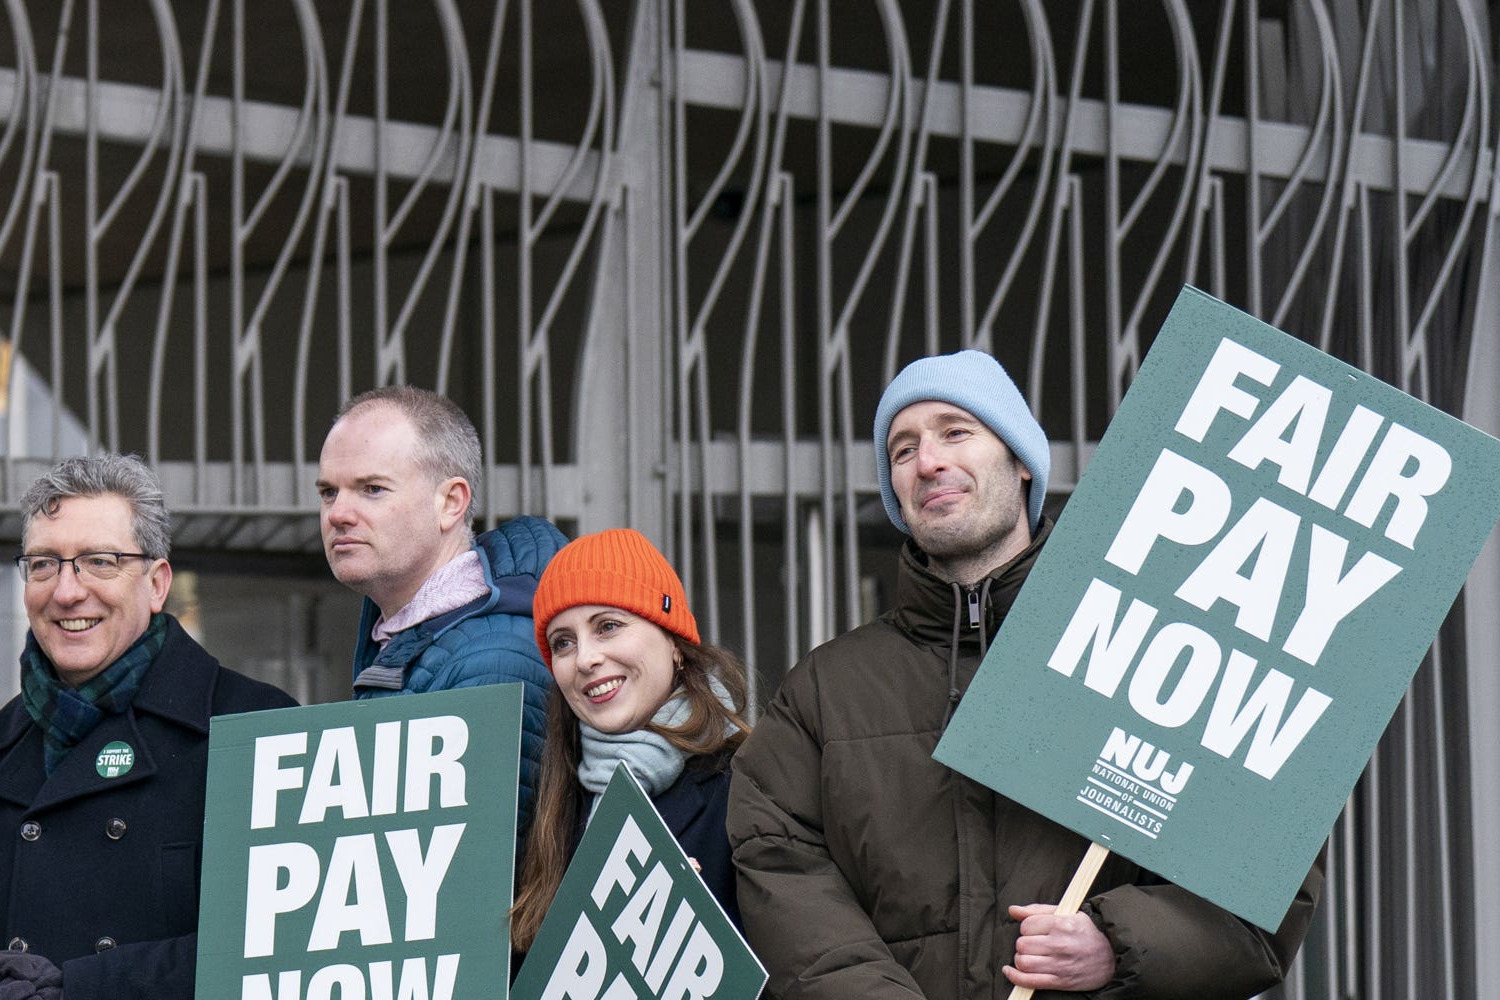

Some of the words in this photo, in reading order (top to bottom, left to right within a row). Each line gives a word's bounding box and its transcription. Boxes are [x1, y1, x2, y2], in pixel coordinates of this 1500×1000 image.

[1175, 338, 1451, 549] FAIR
[1105, 448, 1403, 665] PAY
[1047, 578, 1332, 780] NOW
[97, 754, 132, 766] STRIKE
[251, 716, 468, 829] FAIR
[1092, 764, 1140, 794] NATIONAL
[1142, 790, 1174, 811] UNION
[1100, 727, 1195, 794] NUJ
[1121, 793, 1133, 803] OF
[1080, 786, 1162, 833] JOURNALISTS
[244, 823, 466, 958] PAY
